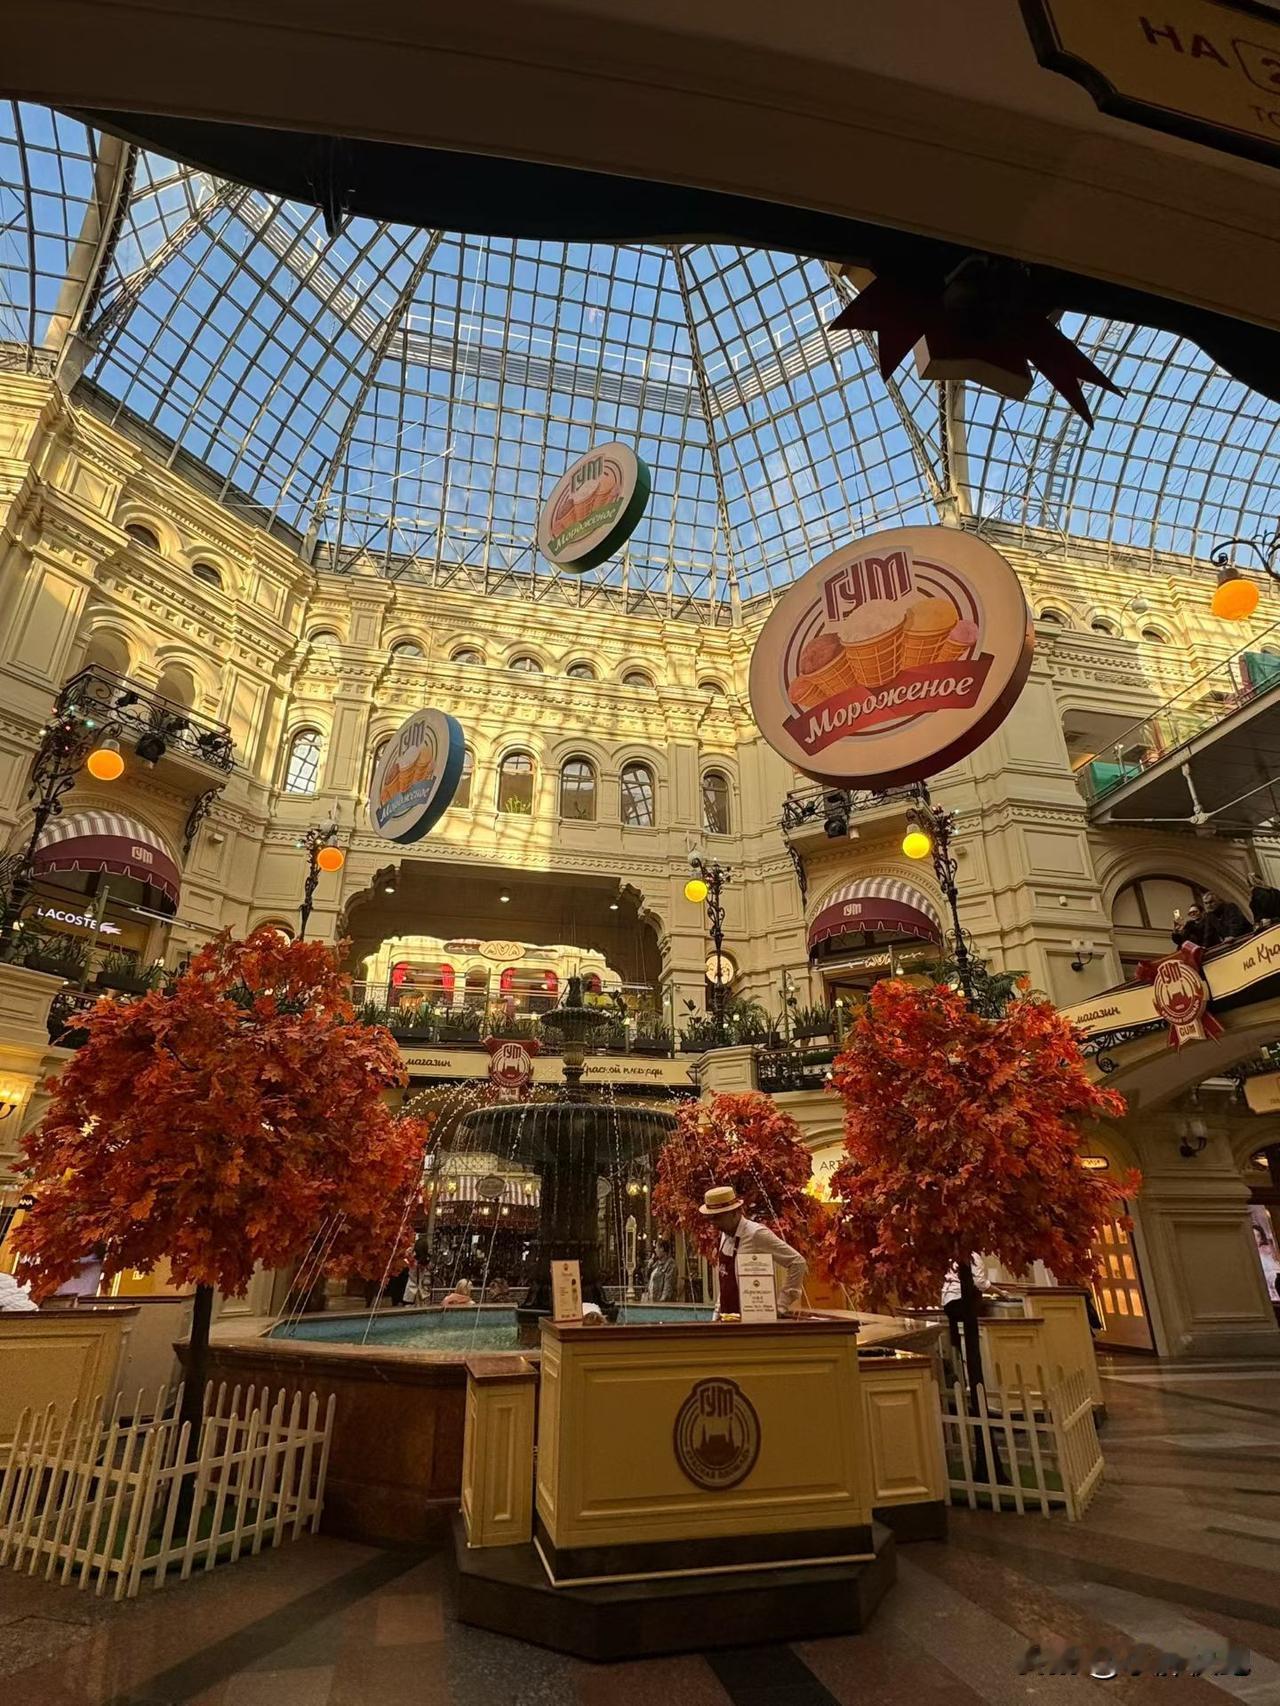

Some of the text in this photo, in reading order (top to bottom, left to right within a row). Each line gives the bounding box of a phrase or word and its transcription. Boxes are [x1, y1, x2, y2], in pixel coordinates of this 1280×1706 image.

[804, 676, 974, 744] Мороженое
[37, 907, 98, 930] LACOSTE
[1242, 957, 1256, 971] на
[1075, 1006, 1121, 1024] магазин
[406, 1058, 452, 1067] магазин
